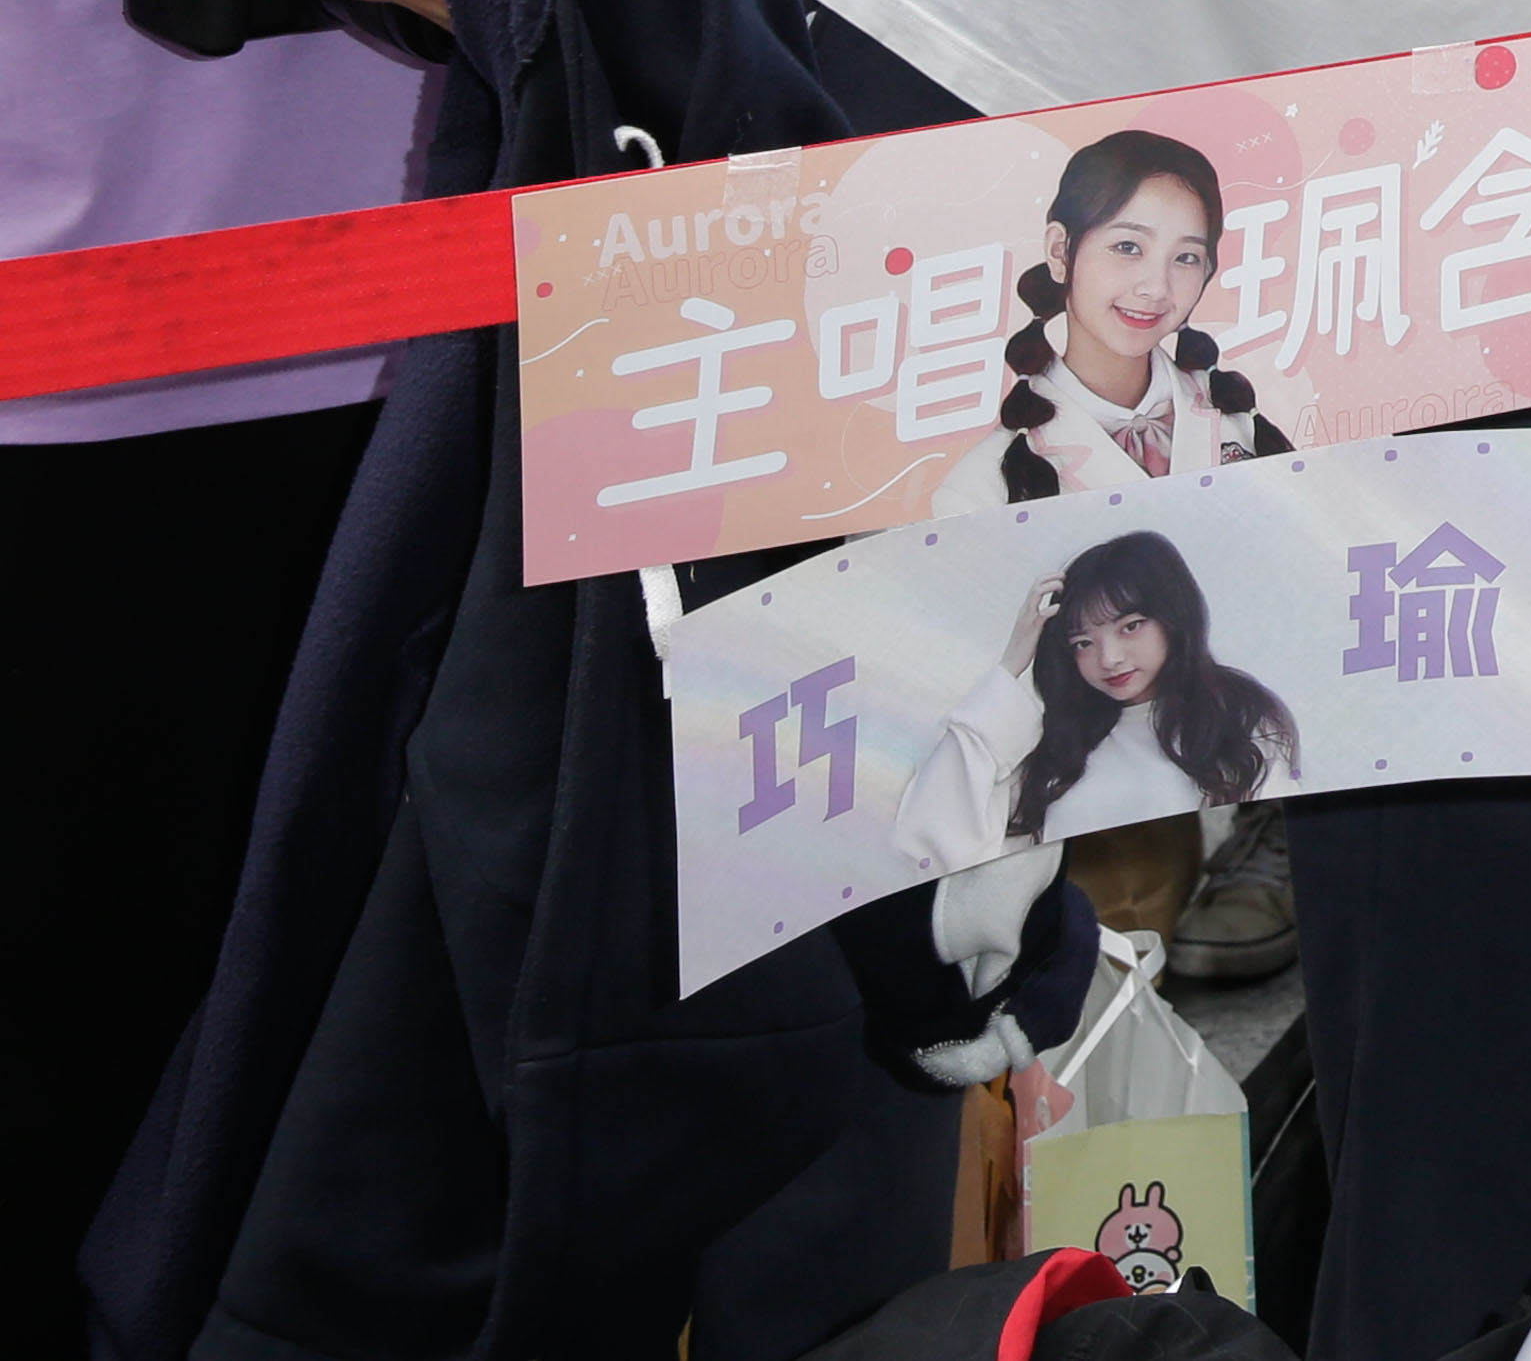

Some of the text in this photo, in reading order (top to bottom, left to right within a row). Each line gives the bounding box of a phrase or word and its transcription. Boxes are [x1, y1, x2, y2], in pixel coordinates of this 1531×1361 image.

[599, 181, 835, 266] Aurora
[597, 243, 1011, 508] 主唱
[737, 520, 1507, 837] 巧 瑜
